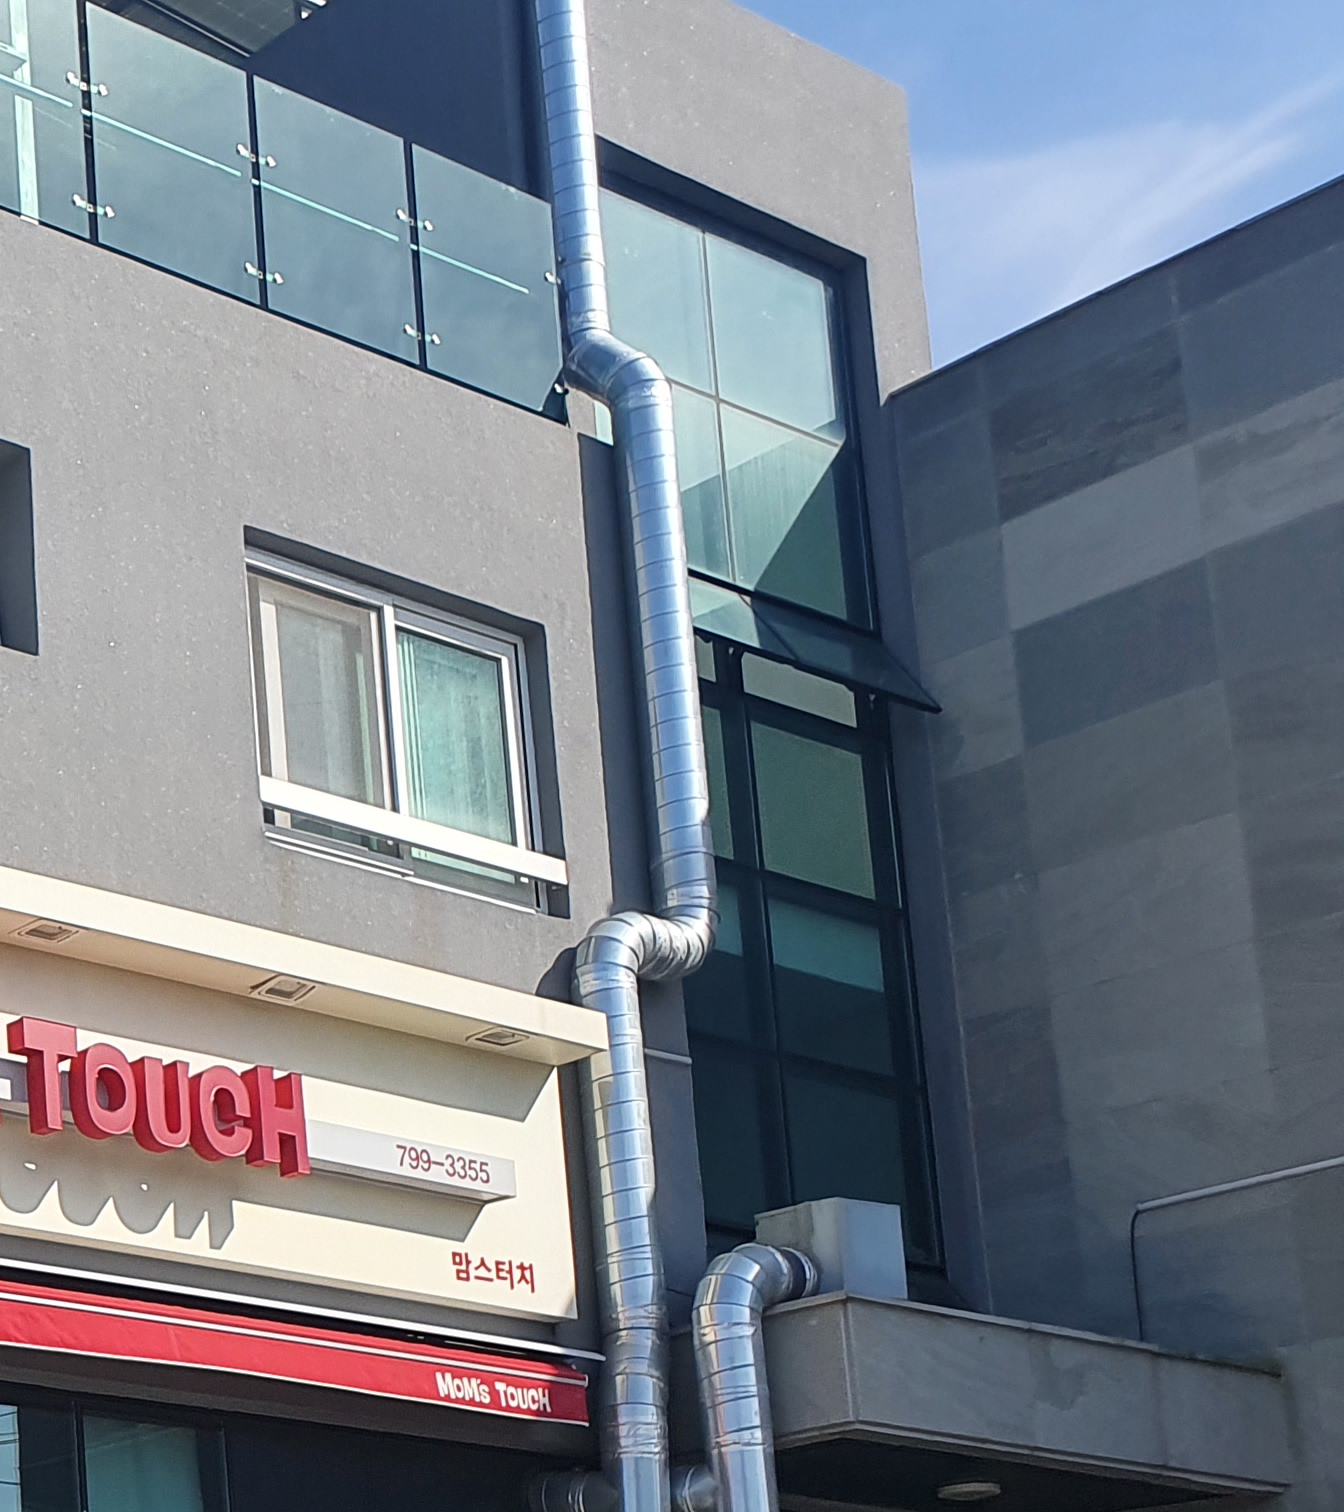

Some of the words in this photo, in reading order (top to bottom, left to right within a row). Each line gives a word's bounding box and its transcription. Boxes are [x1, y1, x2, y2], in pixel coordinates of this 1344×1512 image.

[7, 1016, 310, 1178] TOUCH
[395, 1145, 491, 1184] 799-3355
[452, 1251, 535, 1294] 맘스터치
[495, 1381, 551, 1413] TOUCH
